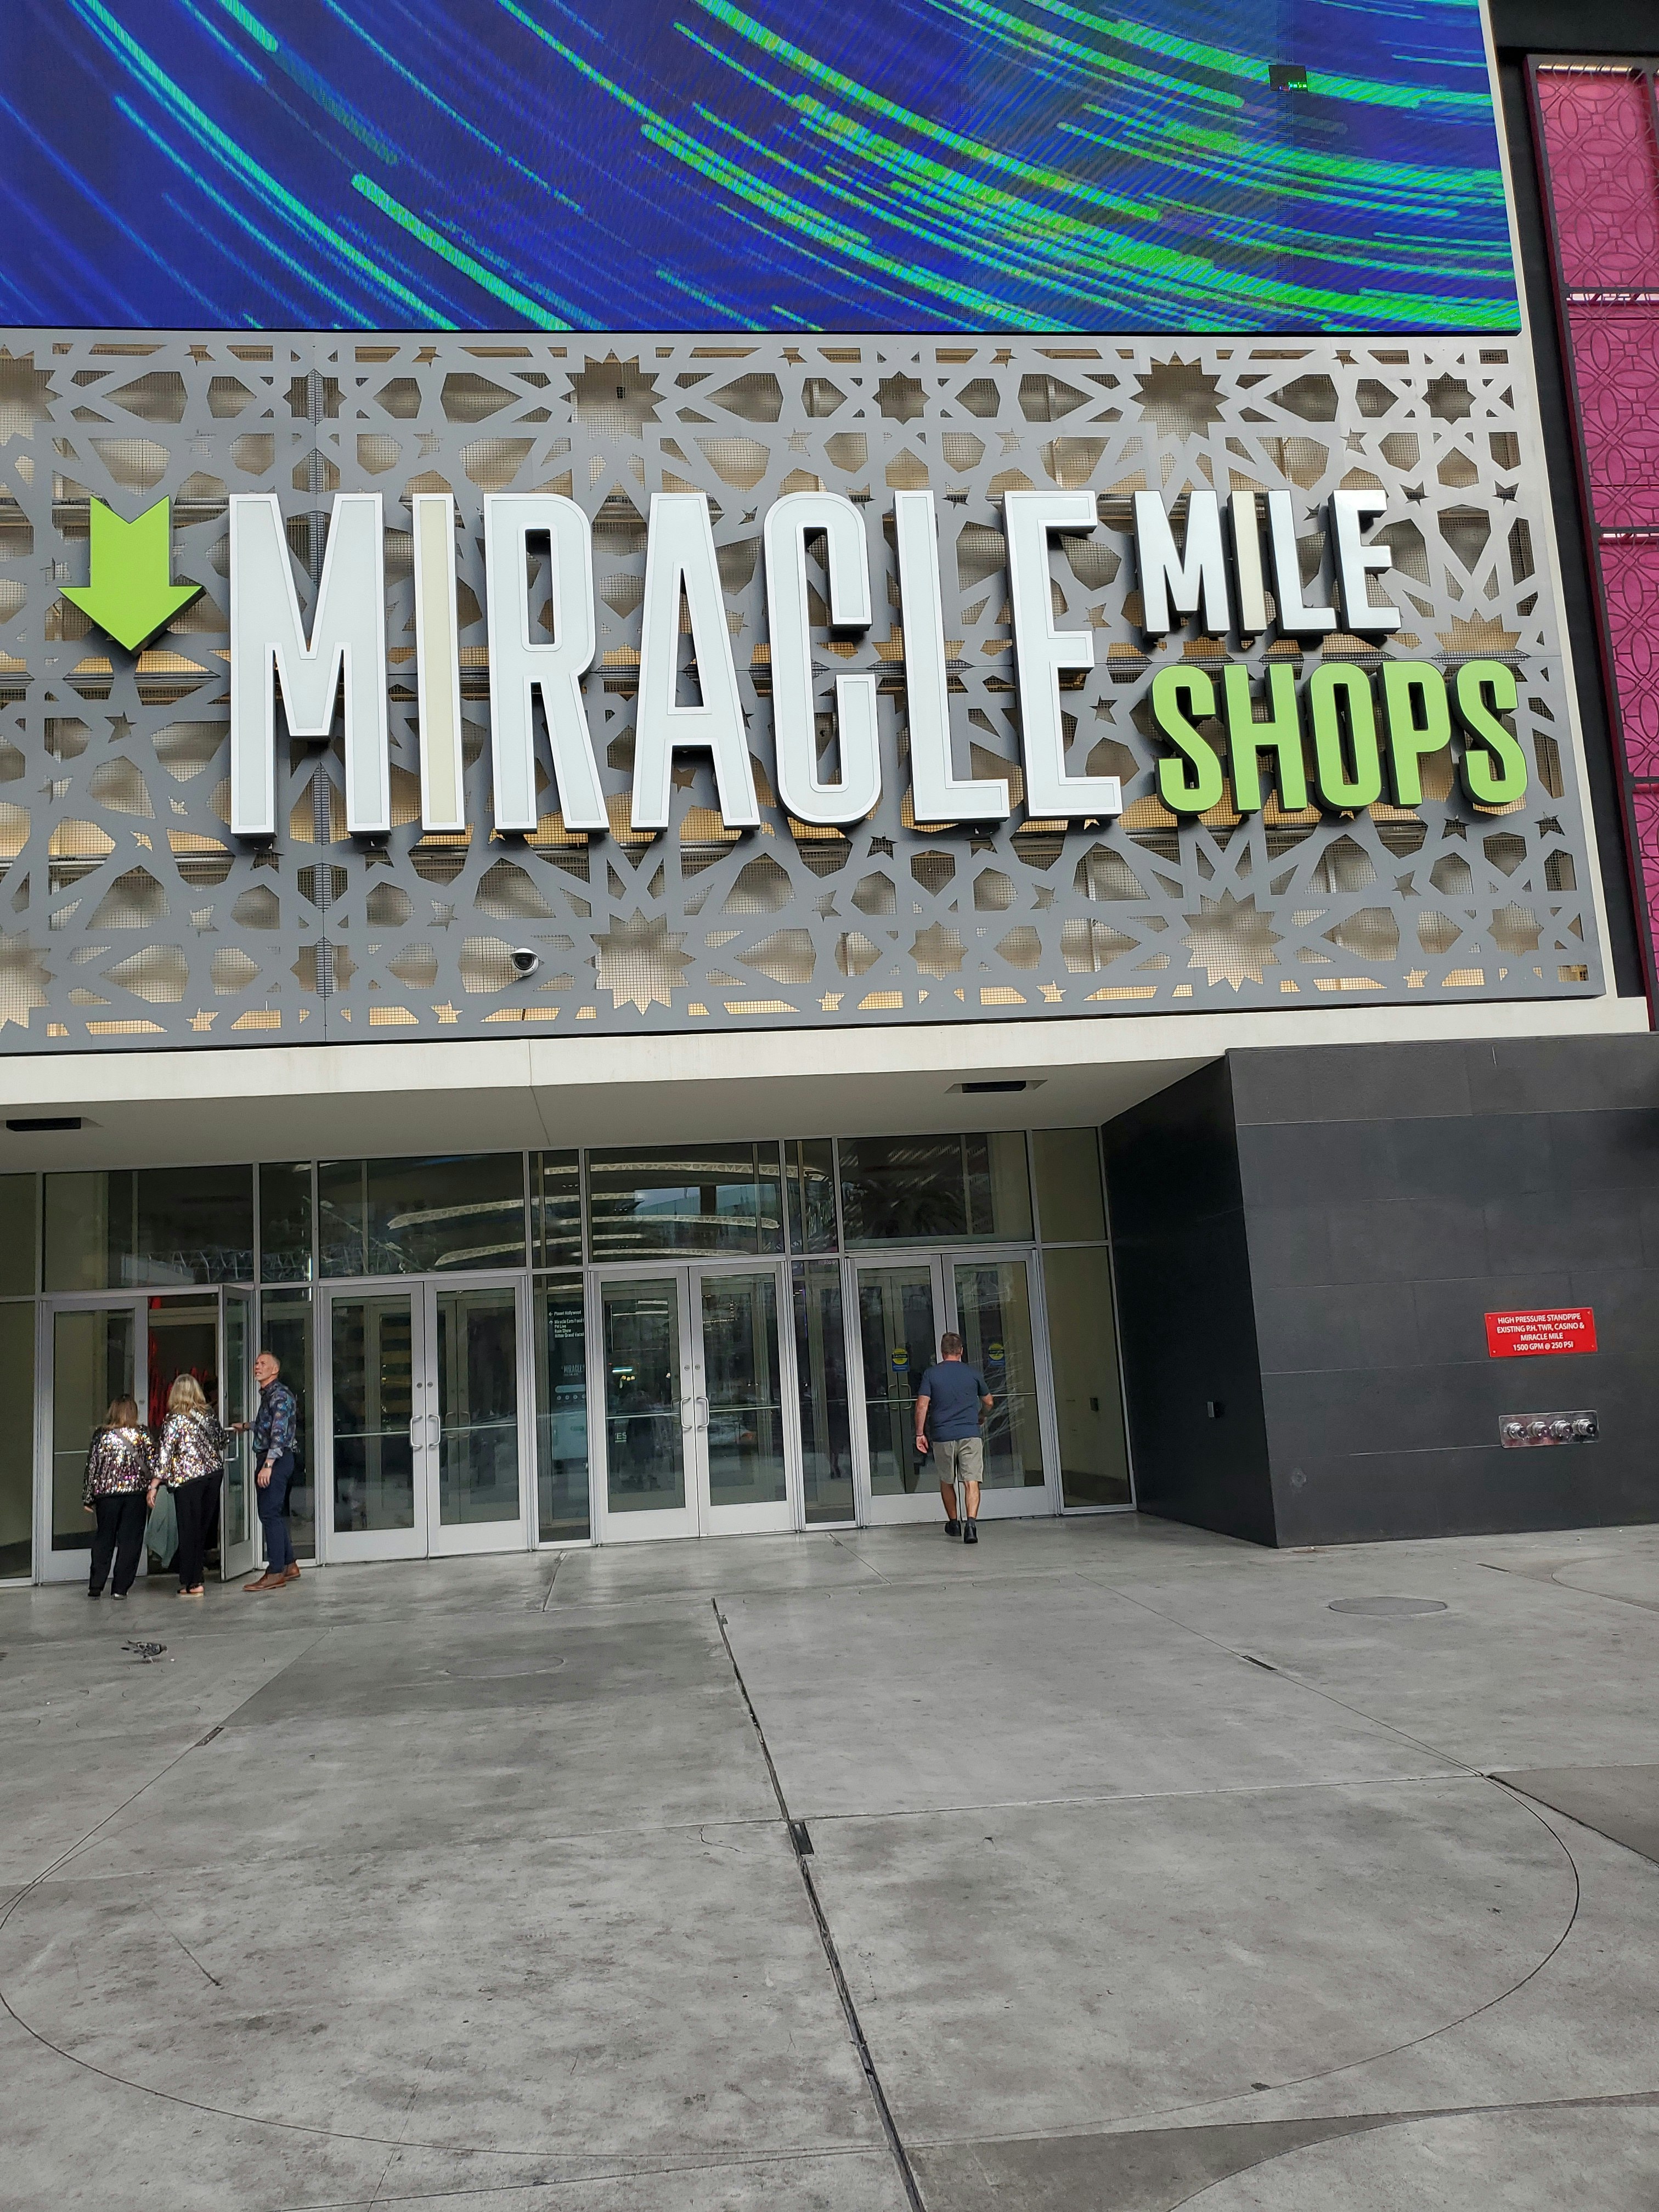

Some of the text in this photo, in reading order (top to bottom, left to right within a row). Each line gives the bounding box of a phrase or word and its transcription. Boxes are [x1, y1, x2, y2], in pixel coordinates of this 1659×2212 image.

[1132, 489, 1402, 635] MILE
[229, 489, 1123, 836] MIRACLE
[1151, 659, 1528, 814] SHOPS
[1497, 1325, 1526, 1334] EXISTING
[1515, 1315, 1547, 1323] PRESSURE
[1547, 1313, 1581, 1322] STANDPIPE
